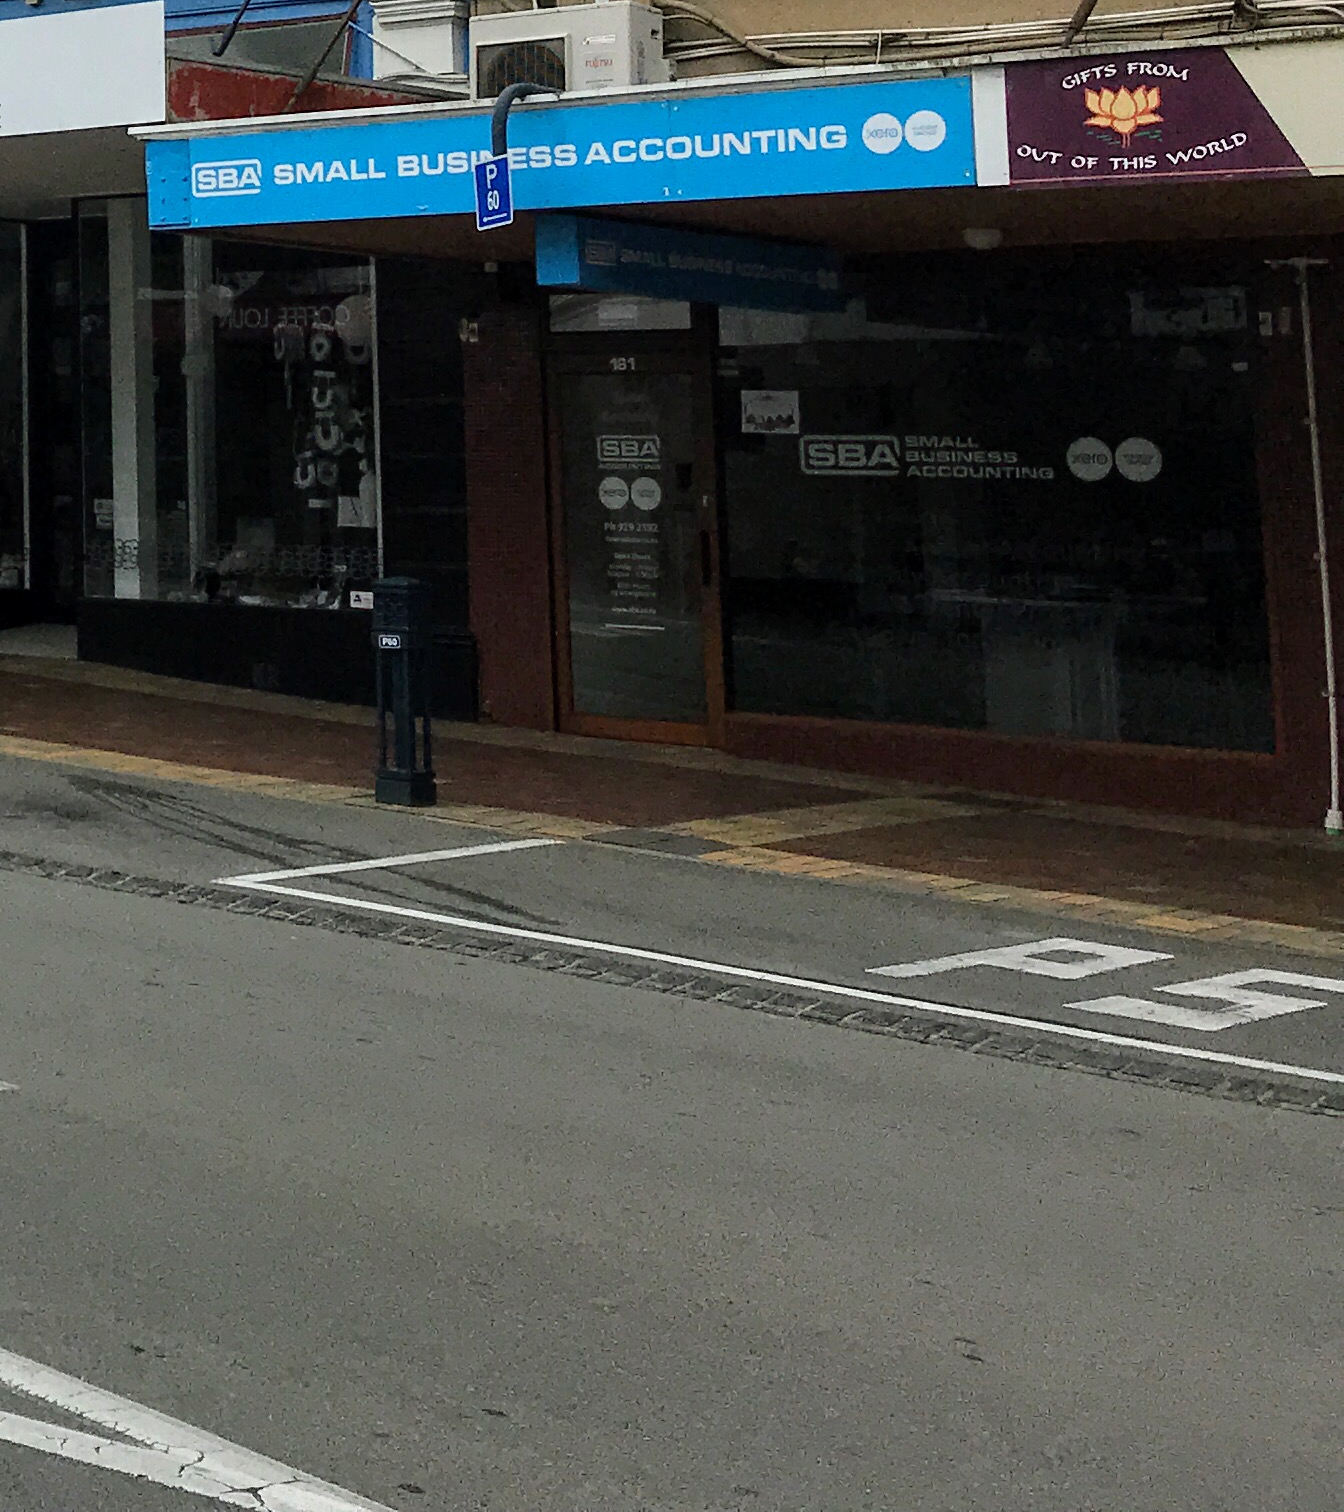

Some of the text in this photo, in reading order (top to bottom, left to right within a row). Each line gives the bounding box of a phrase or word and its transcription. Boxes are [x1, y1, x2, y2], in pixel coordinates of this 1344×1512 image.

[1061, 61, 1191, 90] GIFTS FROM
[198, 166, 262, 191] SBA
[273, 157, 387, 185] SMALL
[584, 124, 847, 166] ACCOUNTING
[1016, 132, 1249, 171] OUT OF THIS WORLD
[485, 163, 498, 189] P
[487, 190, 500, 211] 60
[609, 356, 636, 371] 181
[602, 440, 661, 457] SBA
[904, 435, 979, 449] SMALL
[808, 443, 900, 468] SBA
[905, 451, 1019, 464] BUSINESS
[905, 465, 1055, 480] ACCOUNTING
